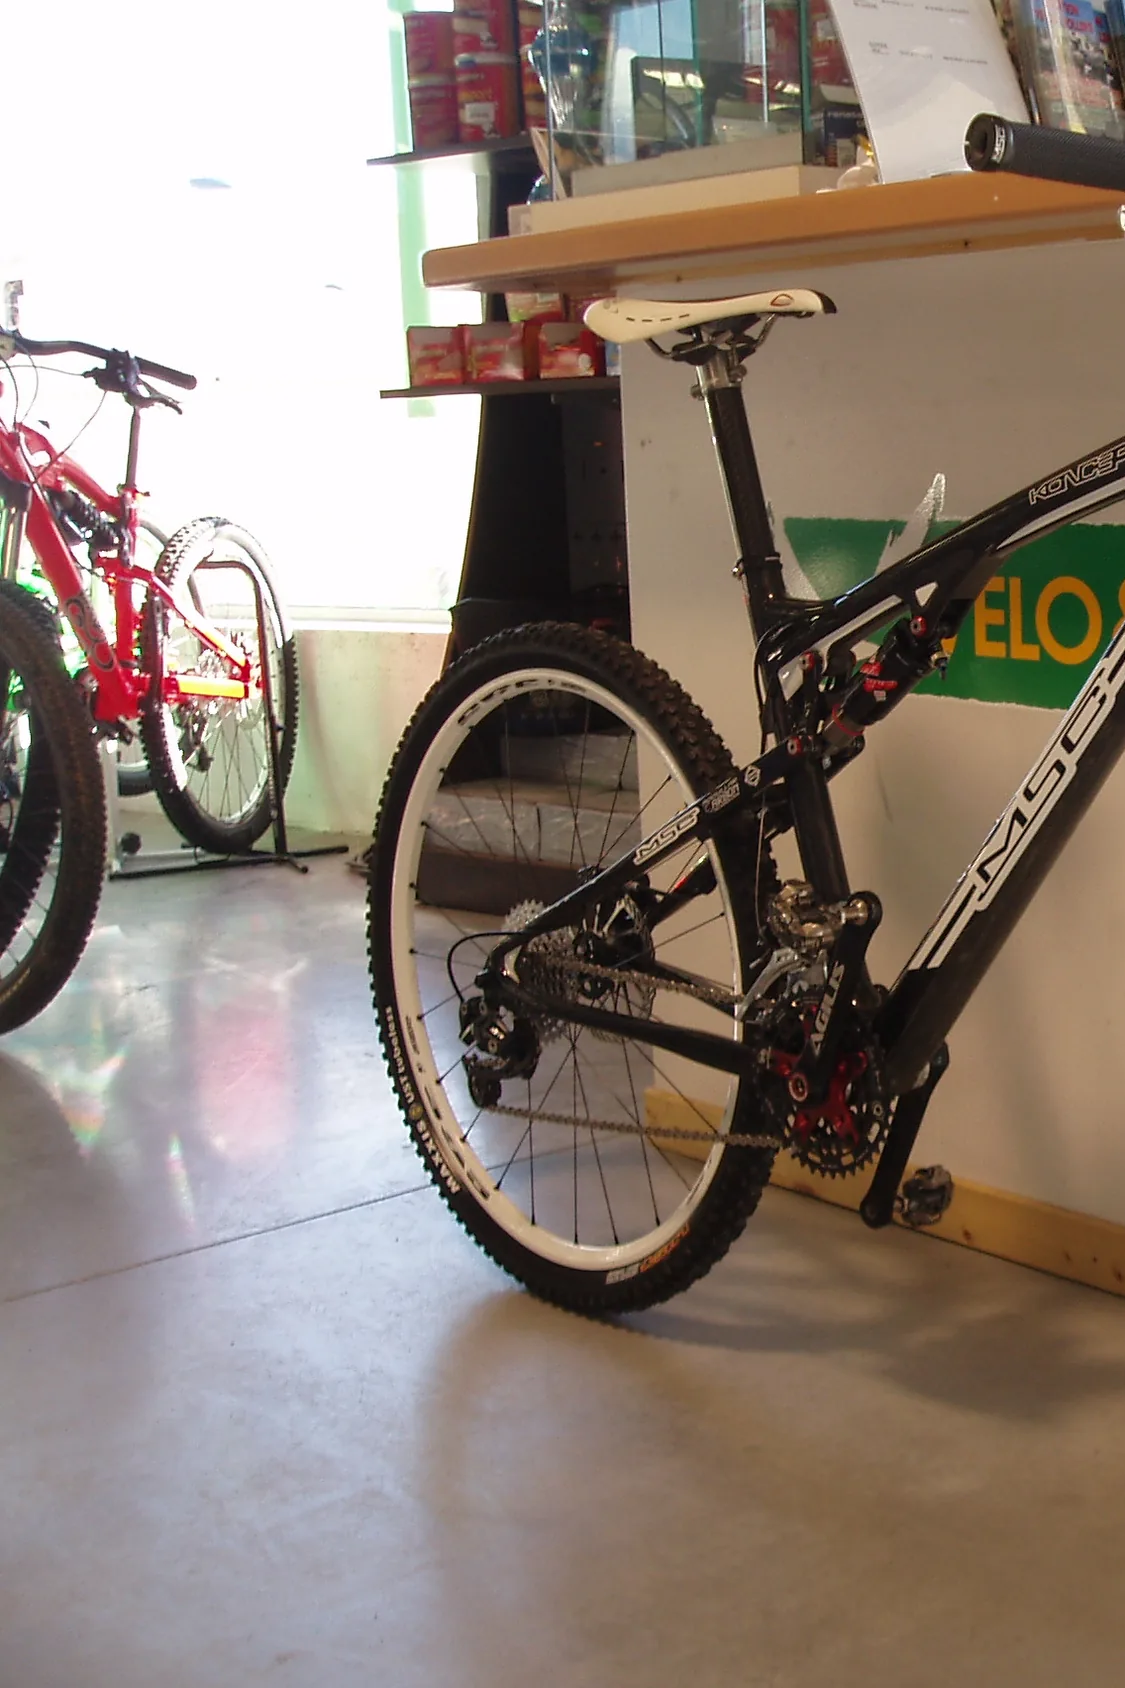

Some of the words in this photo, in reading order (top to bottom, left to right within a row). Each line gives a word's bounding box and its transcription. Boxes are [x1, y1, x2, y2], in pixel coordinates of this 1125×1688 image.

[958, 655, 1118, 912] MSC
[633, 806, 700, 865] MSC
[416, 1119, 461, 1194] MAXXIS
